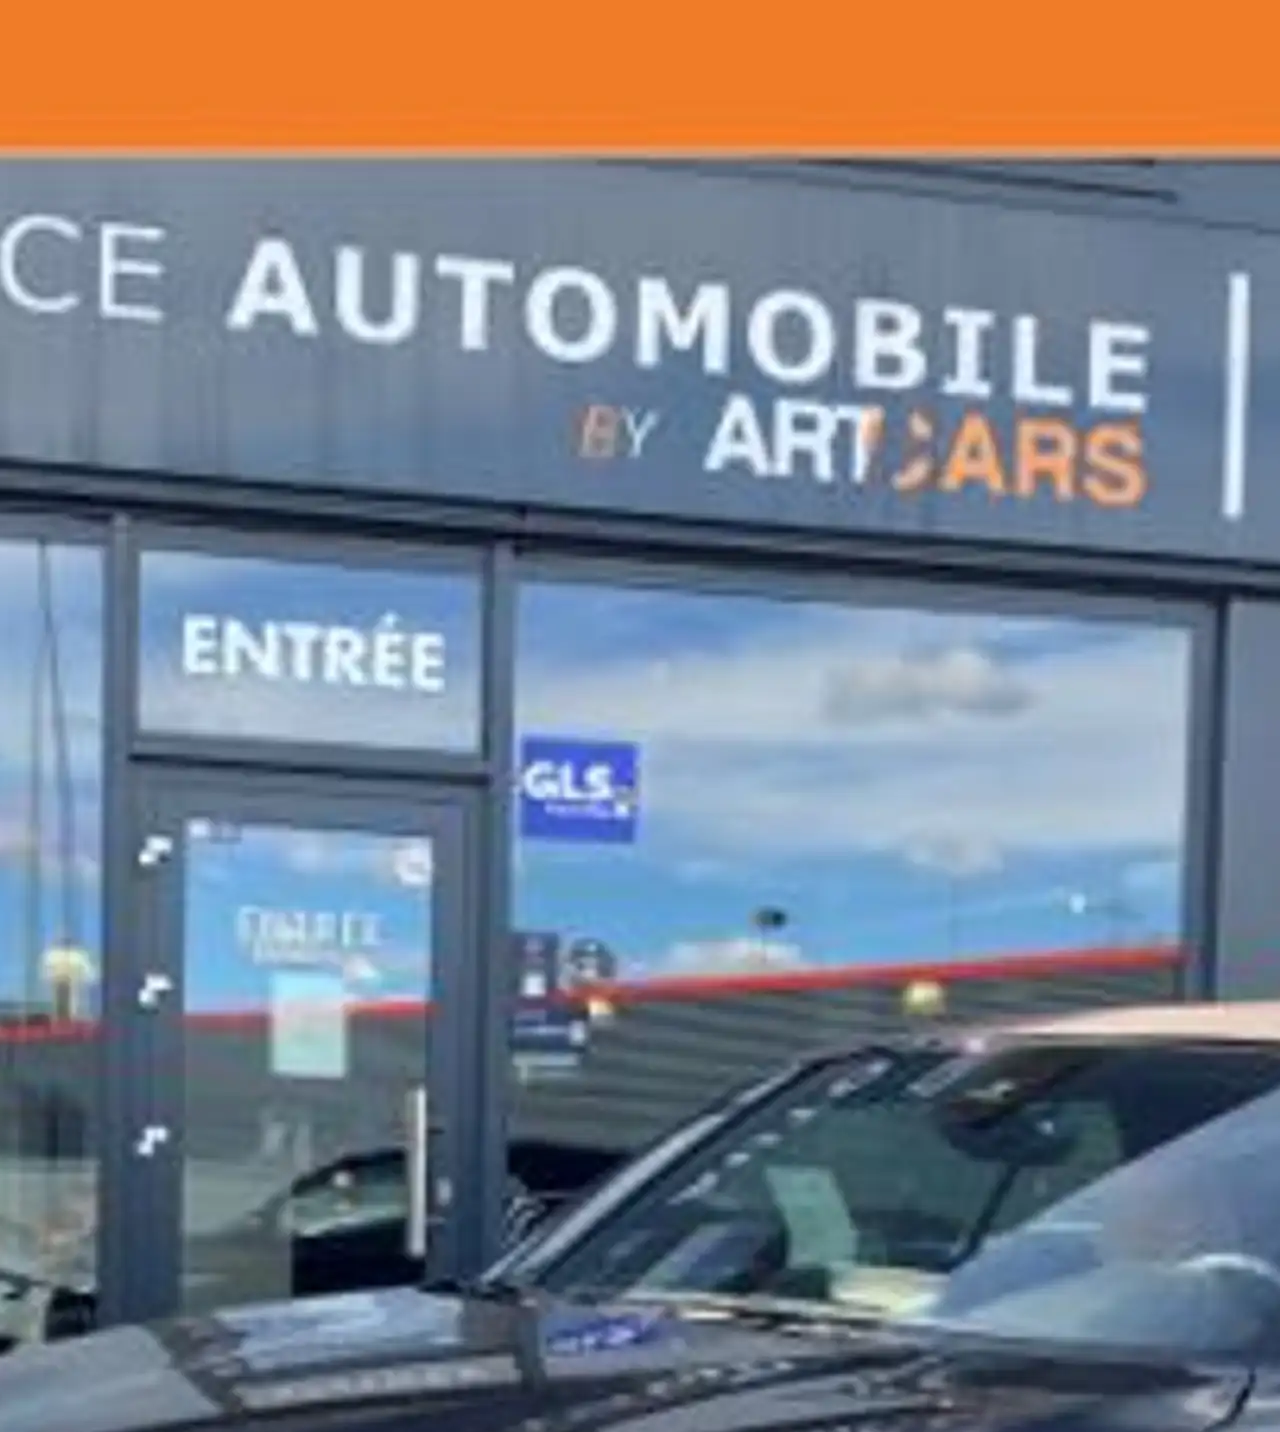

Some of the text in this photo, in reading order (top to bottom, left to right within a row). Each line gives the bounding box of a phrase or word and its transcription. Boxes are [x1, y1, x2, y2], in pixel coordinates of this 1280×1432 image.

[225, 238, 1152, 413] AUTOMOBILE
[577, 402, 658, 460] BY
[181, 608, 447, 693] ENTRÉE
[523, 758, 616, 800] GLS
